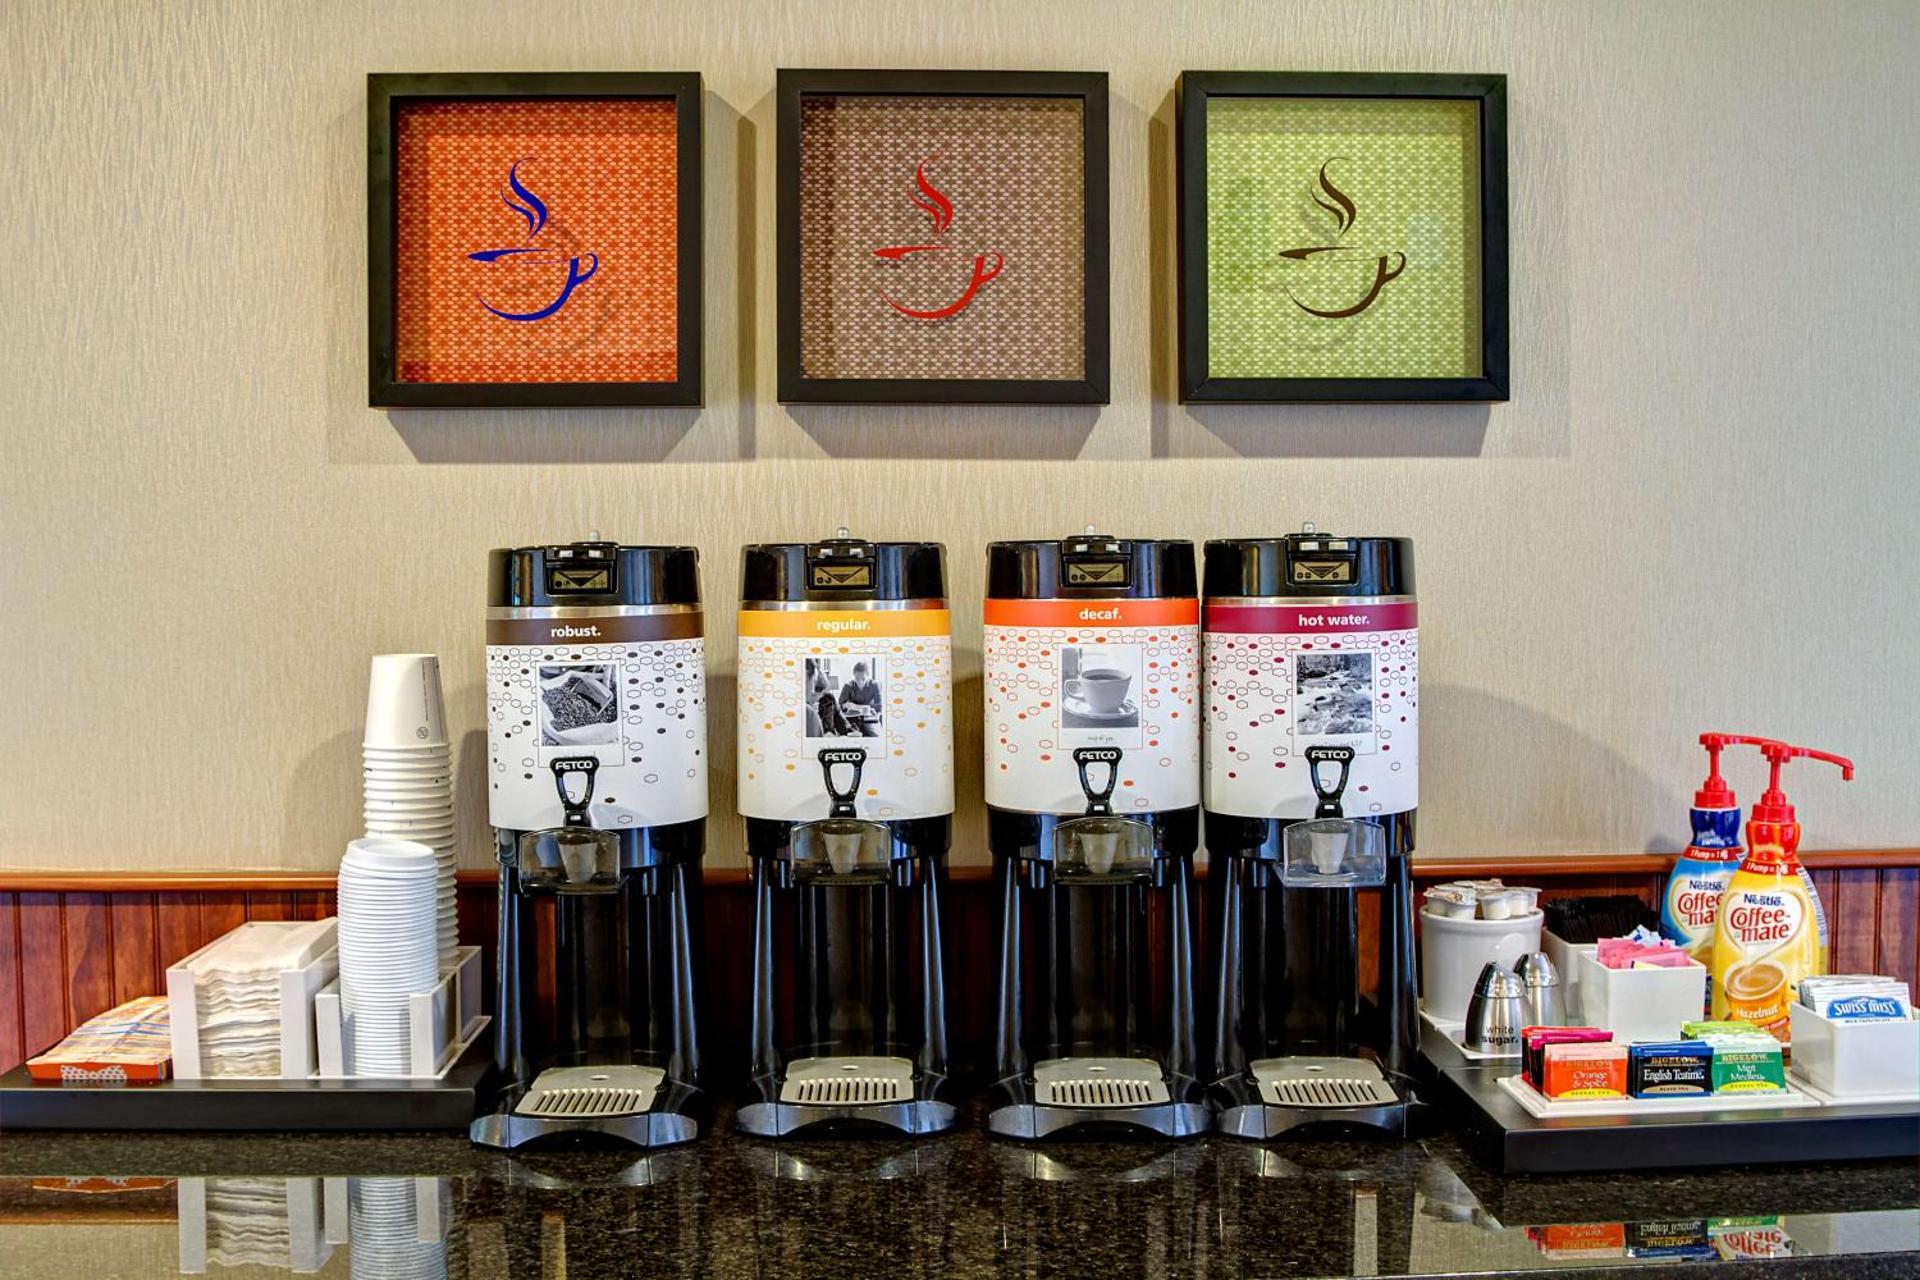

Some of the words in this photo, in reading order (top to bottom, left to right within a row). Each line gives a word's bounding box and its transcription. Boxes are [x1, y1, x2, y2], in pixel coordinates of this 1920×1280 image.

[1079, 607, 1122, 620] decaf.
[816, 618, 872, 633] regular.
[1298, 614, 1324, 627] hot
[1327, 614, 1370, 626] water.
[551, 624, 601, 637] robust.
[824, 752, 862, 761] FETCO
[1079, 751, 1117, 760] FETCO
[1311, 750, 1349, 759] FETCO
[555, 760, 593, 770] FETCO
[1730, 907, 1791, 929] Coffee-
[1741, 924, 1790, 942] mate
[1736, 1004, 1779, 1019] Hazelnut
[1486, 1024, 1514, 1034] white
[1481, 1035, 1518, 1046] sugar.
[1573, 1070, 1608, 1080] Orange
[1644, 1069, 1672, 1083] English
[1573, 1080, 1582, 1088] &
[1584, 1079, 1608, 1091] Spice
